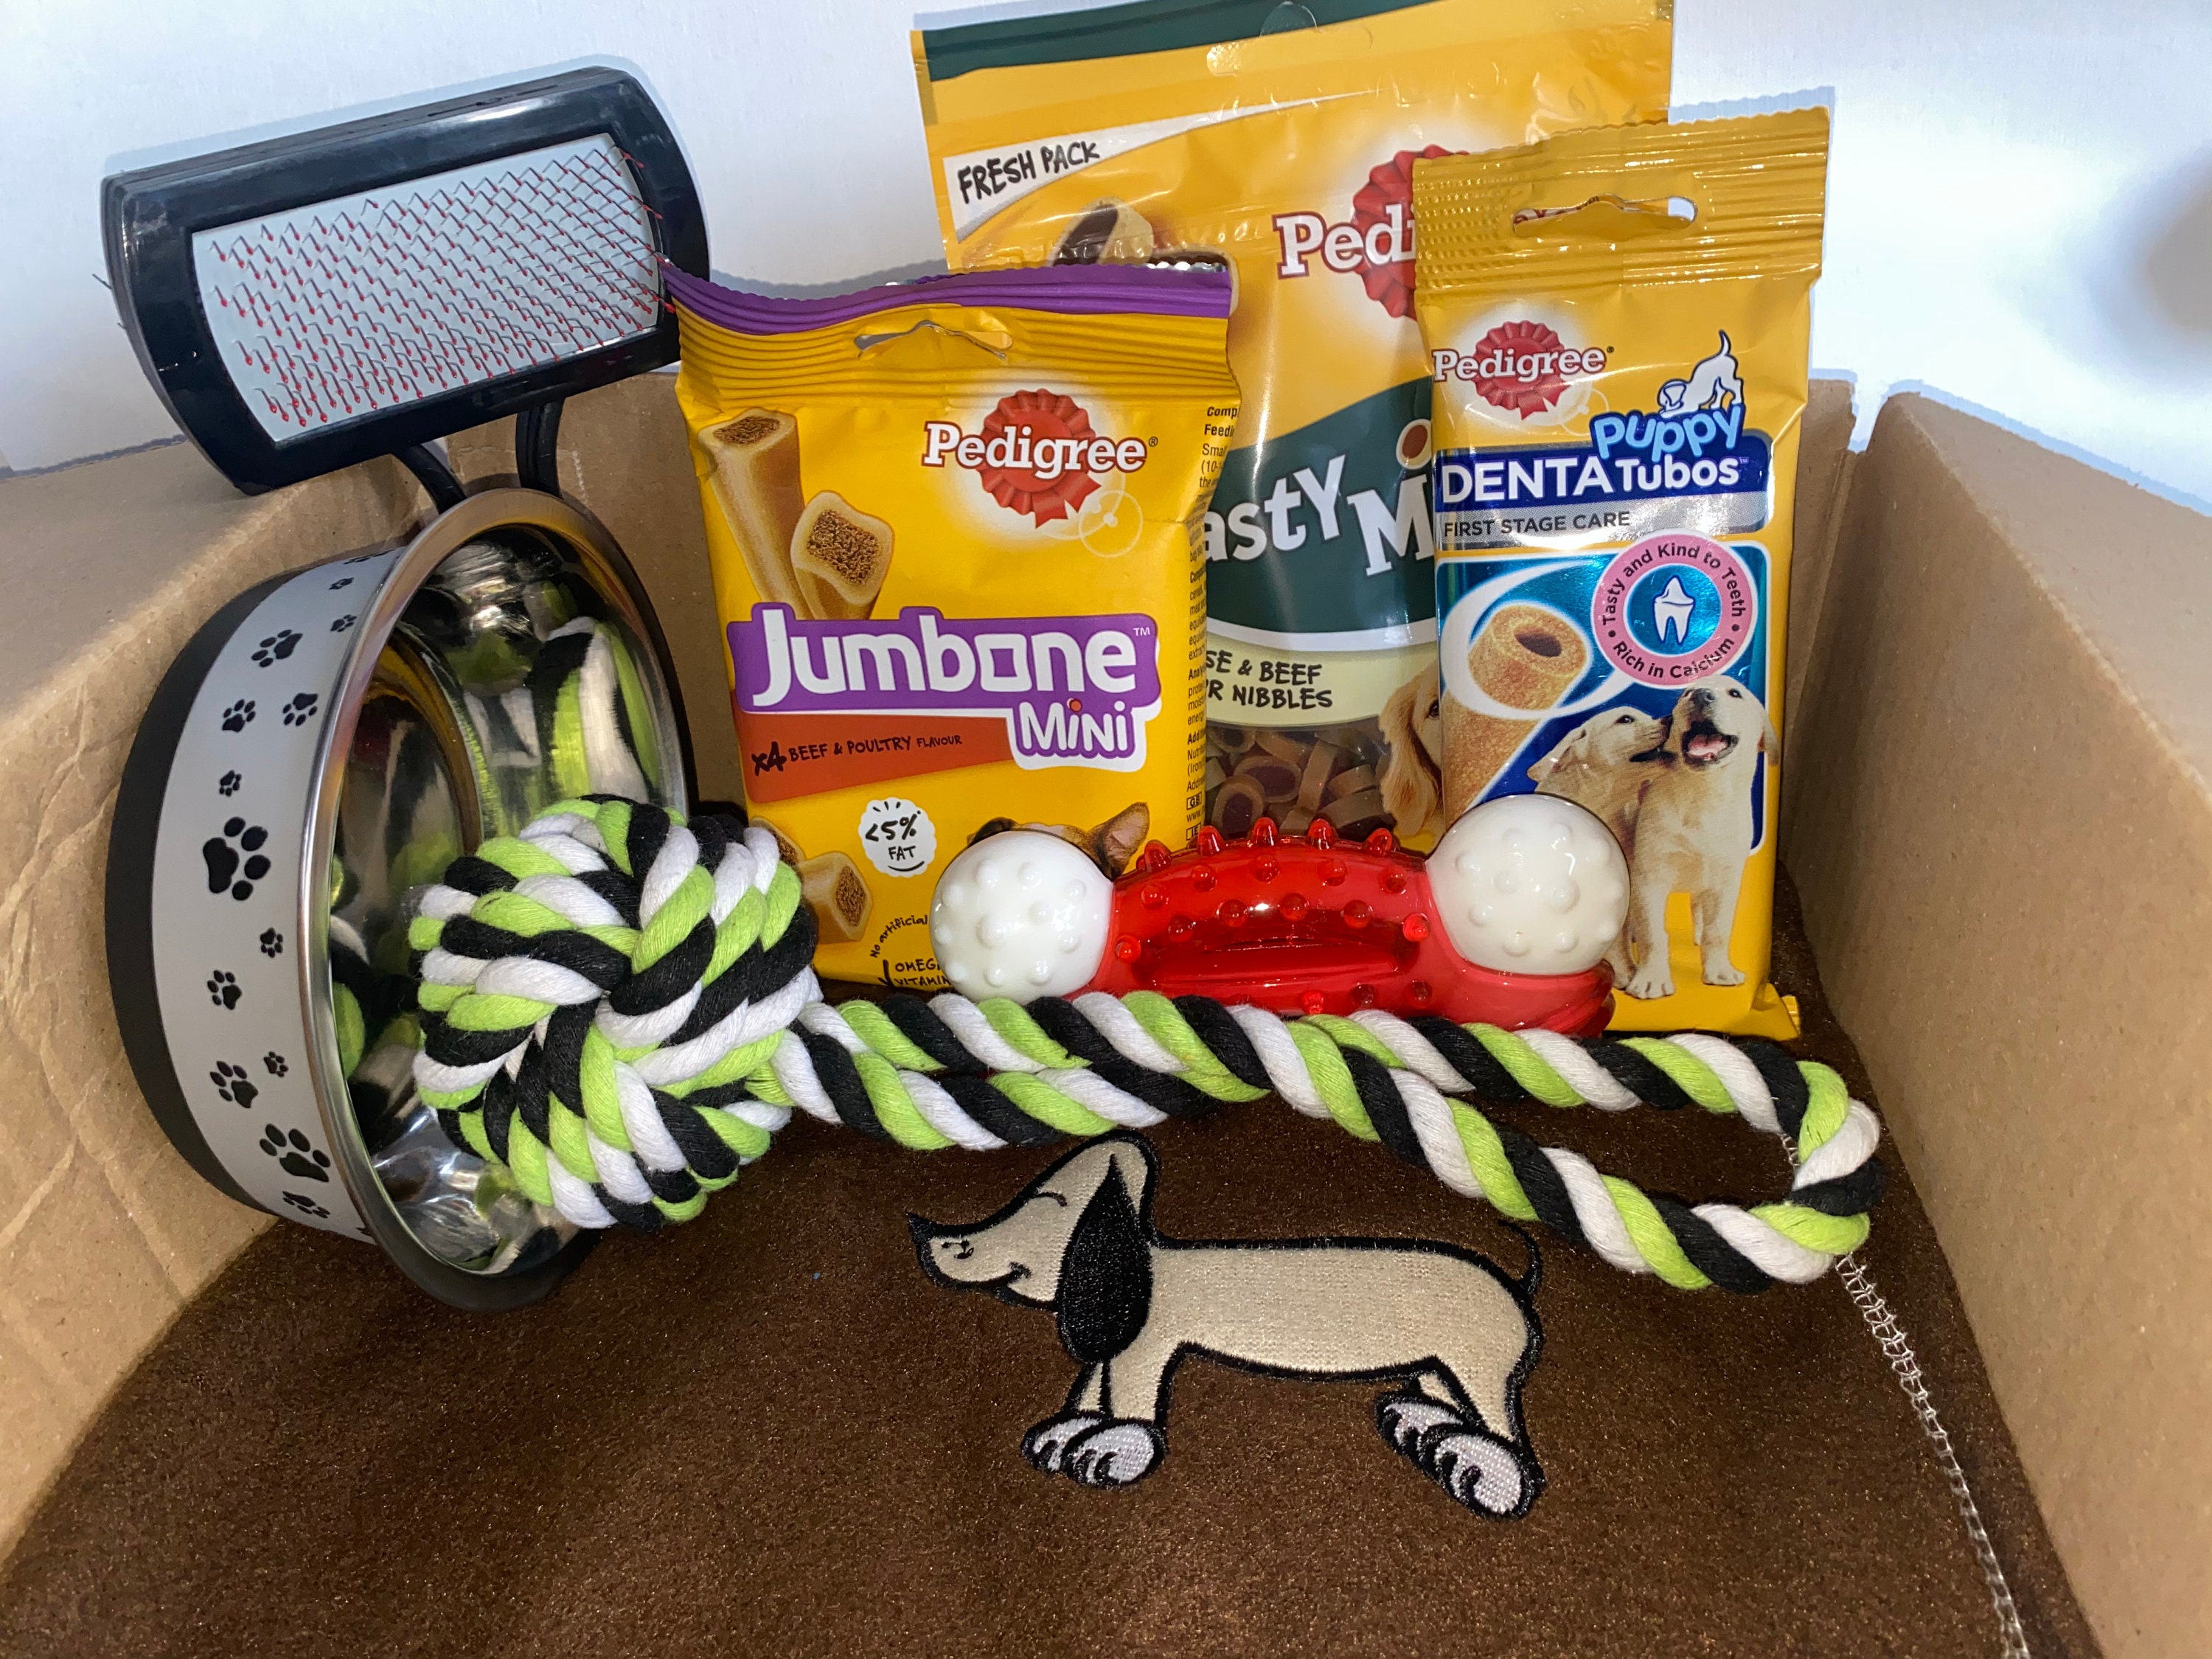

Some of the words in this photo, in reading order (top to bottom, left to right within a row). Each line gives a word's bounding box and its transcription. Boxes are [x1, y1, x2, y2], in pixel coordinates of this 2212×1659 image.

[958, 150, 1036, 204] FRESH
[1040, 141, 1100, 173] PACK
[1347, 474, 1434, 577] M
[1444, 521, 1494, 537] FIRST
[1501, 515, 1566, 534] STAGE
[1573, 510, 1630, 530] CARE
[1602, 577, 1625, 625] Tasty
[1622, 549, 1653, 577] and
[1658, 543, 1700, 559] Kind
[1703, 552, 1720, 569] to
[1722, 567, 1746, 617] Teeth
[1237, 659, 1253, 676] &
[1259, 661, 1322, 686] BEEF
[1613, 640, 1645, 672] Rich
[1648, 663, 1663, 678] in
[1670, 637, 1735, 678] Calcium
[1232, 684, 1333, 709] NIBBLES
[751, 741, 787, 776] x4
[788, 743, 827, 762] BEEF
[833, 742, 843, 756] &
[847, 736, 911, 755] POULTRY
[917, 734, 962, 748] FLAVOUR
[865, 813, 917, 842] <5%
[888, 845, 917, 860] FAT
[870, 945, 881, 959] No
[880, 914, 928, 942] artificial
